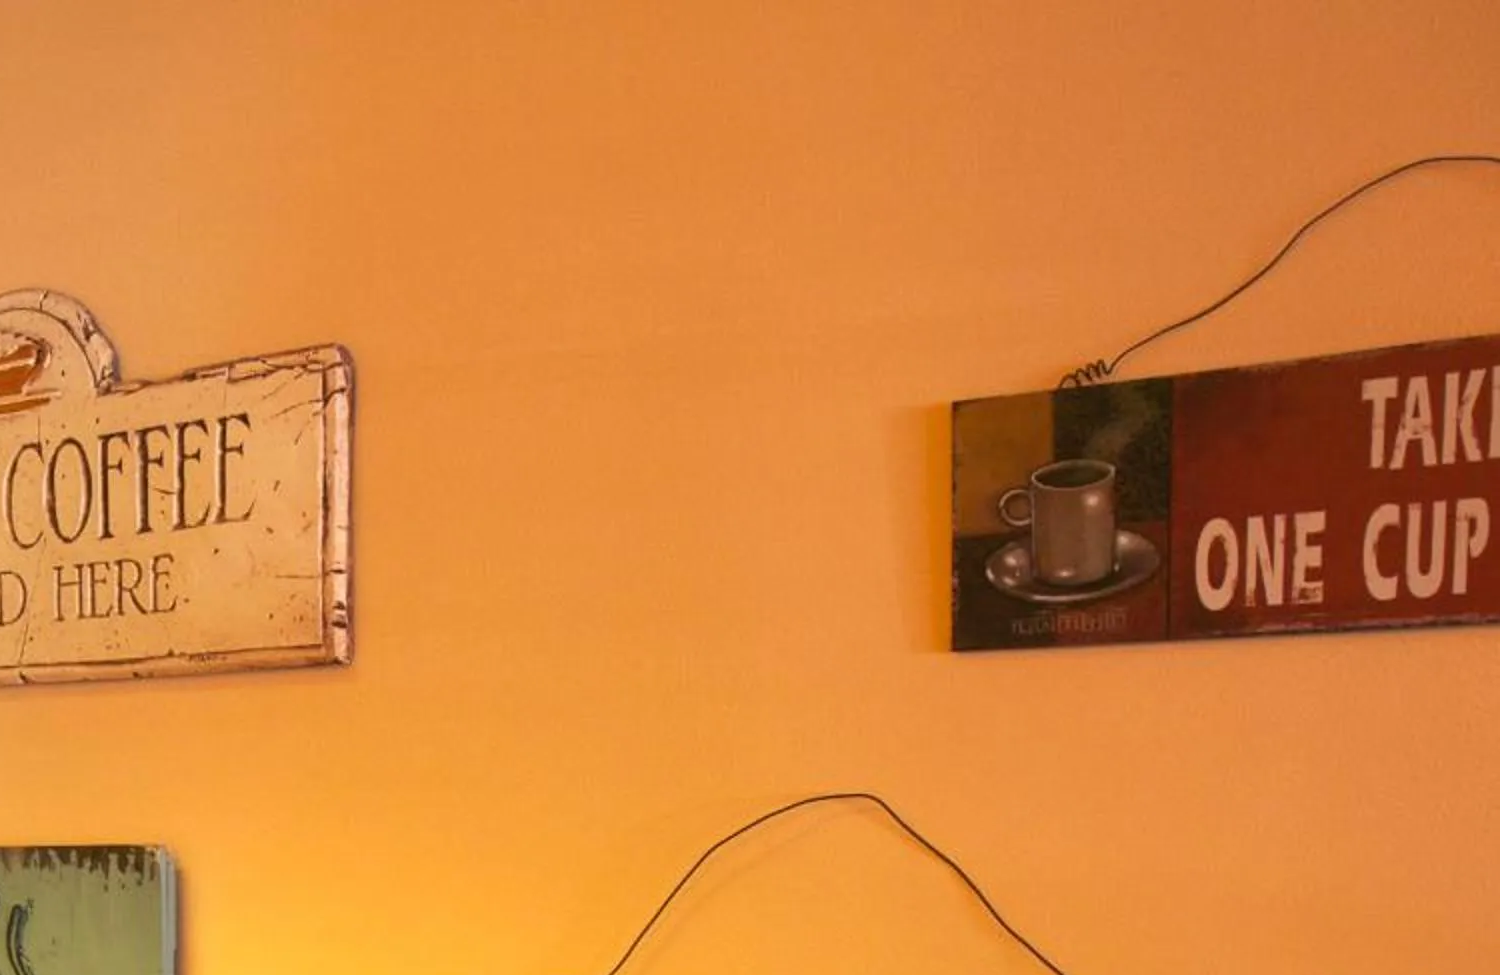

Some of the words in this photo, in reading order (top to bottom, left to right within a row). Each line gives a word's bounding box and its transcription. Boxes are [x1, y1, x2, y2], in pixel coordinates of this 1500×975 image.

[1361, 366, 1500, 470] TAK
[2, 413, 258, 550] COFFEE
[51, 553, 179, 623] HERE
[1194, 510, 1327, 612] ONE
[1362, 497, 1491, 601] CUP
